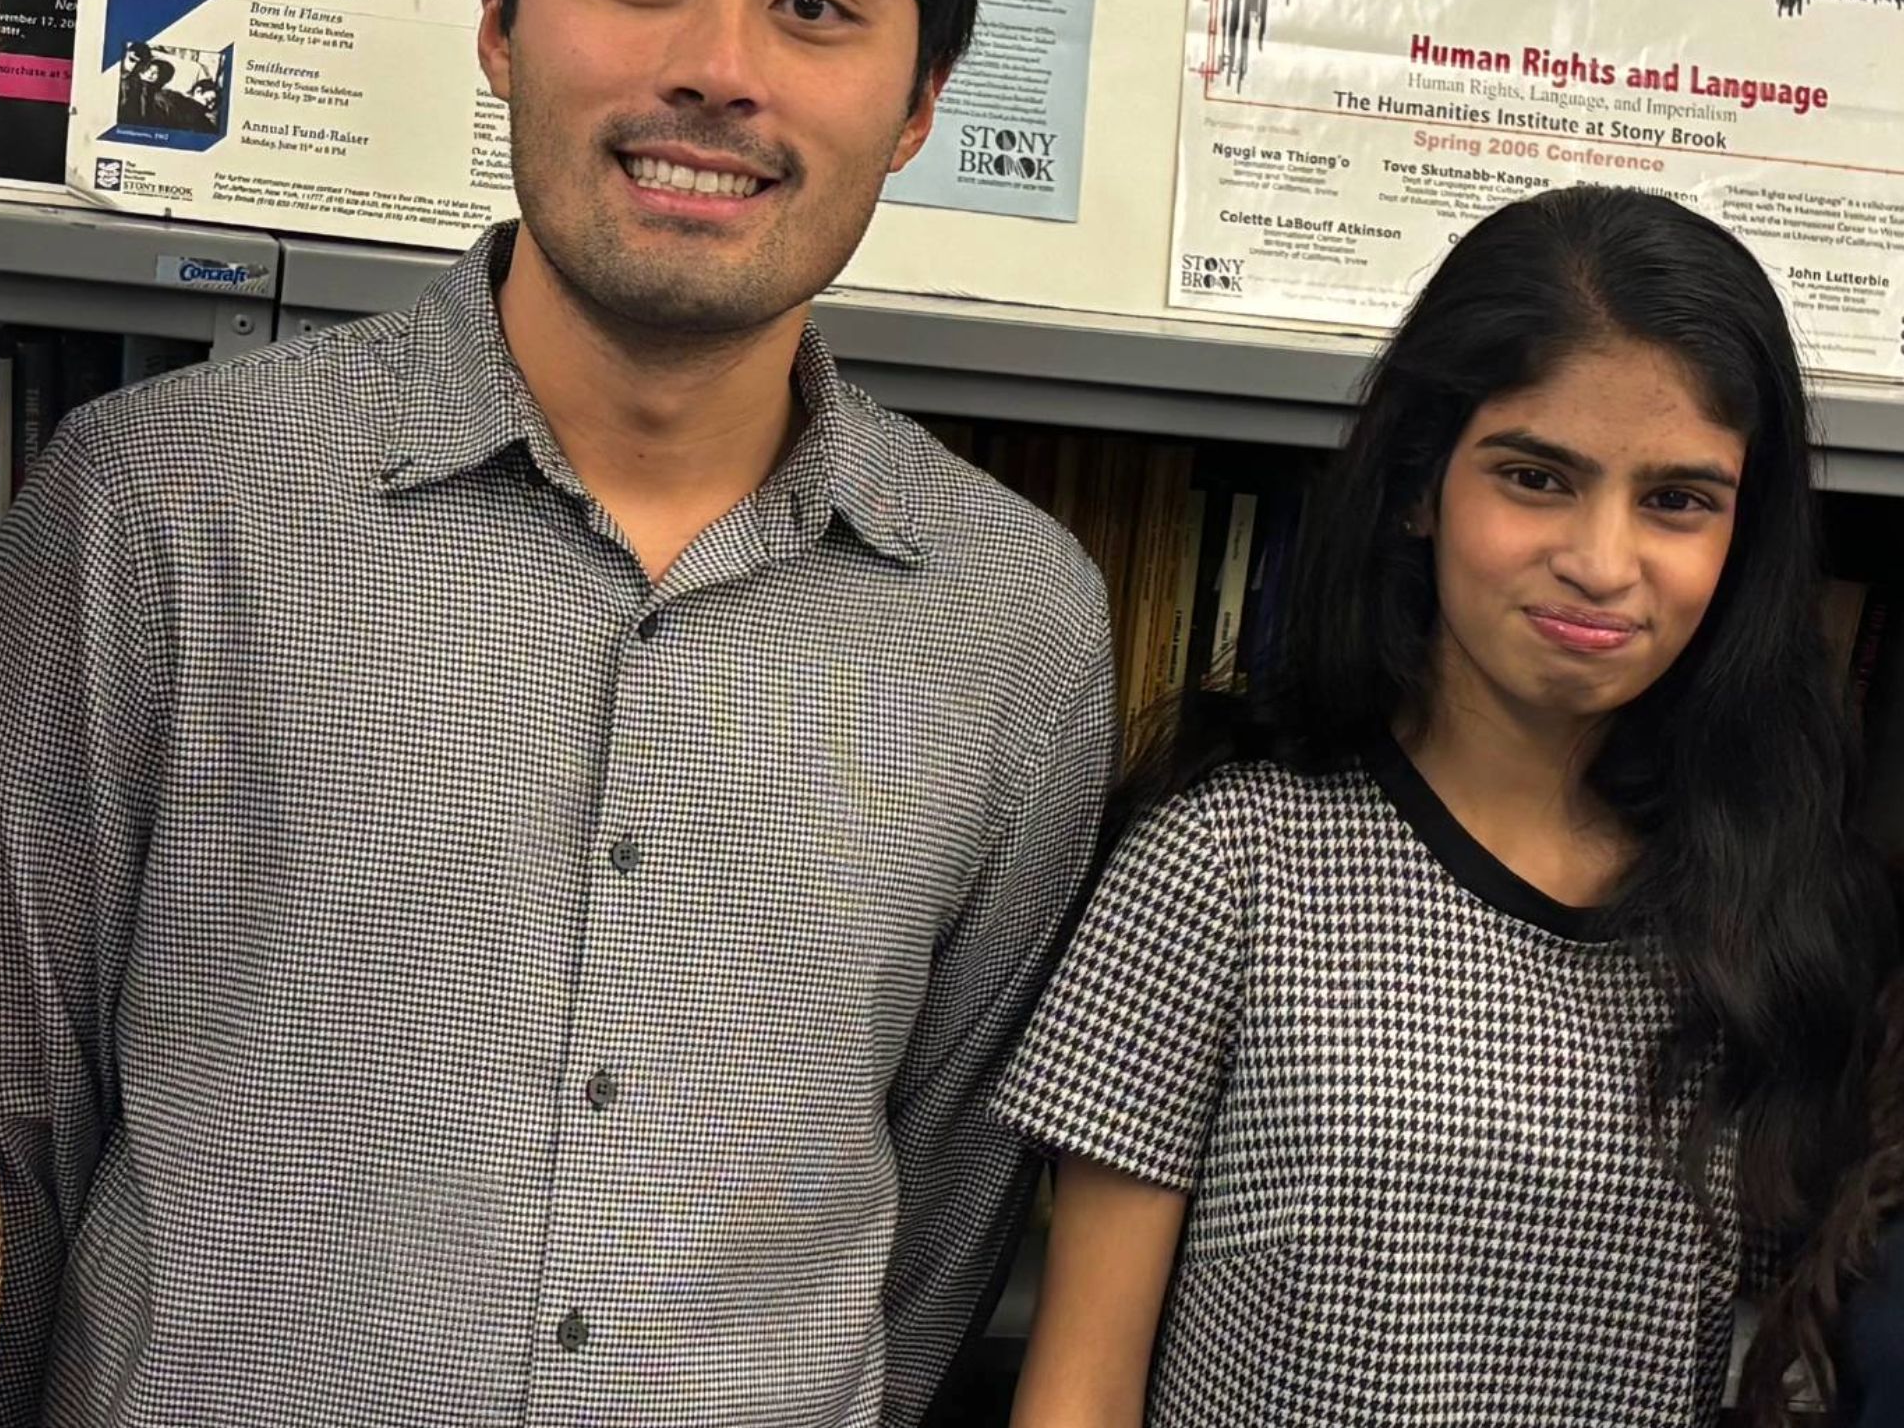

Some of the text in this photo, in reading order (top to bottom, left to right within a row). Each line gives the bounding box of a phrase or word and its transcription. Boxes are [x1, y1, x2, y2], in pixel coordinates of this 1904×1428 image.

[1410, 33, 1828, 115] Human Rights and Language
[1413, 130, 1665, 173] Spring 2006 Conference
